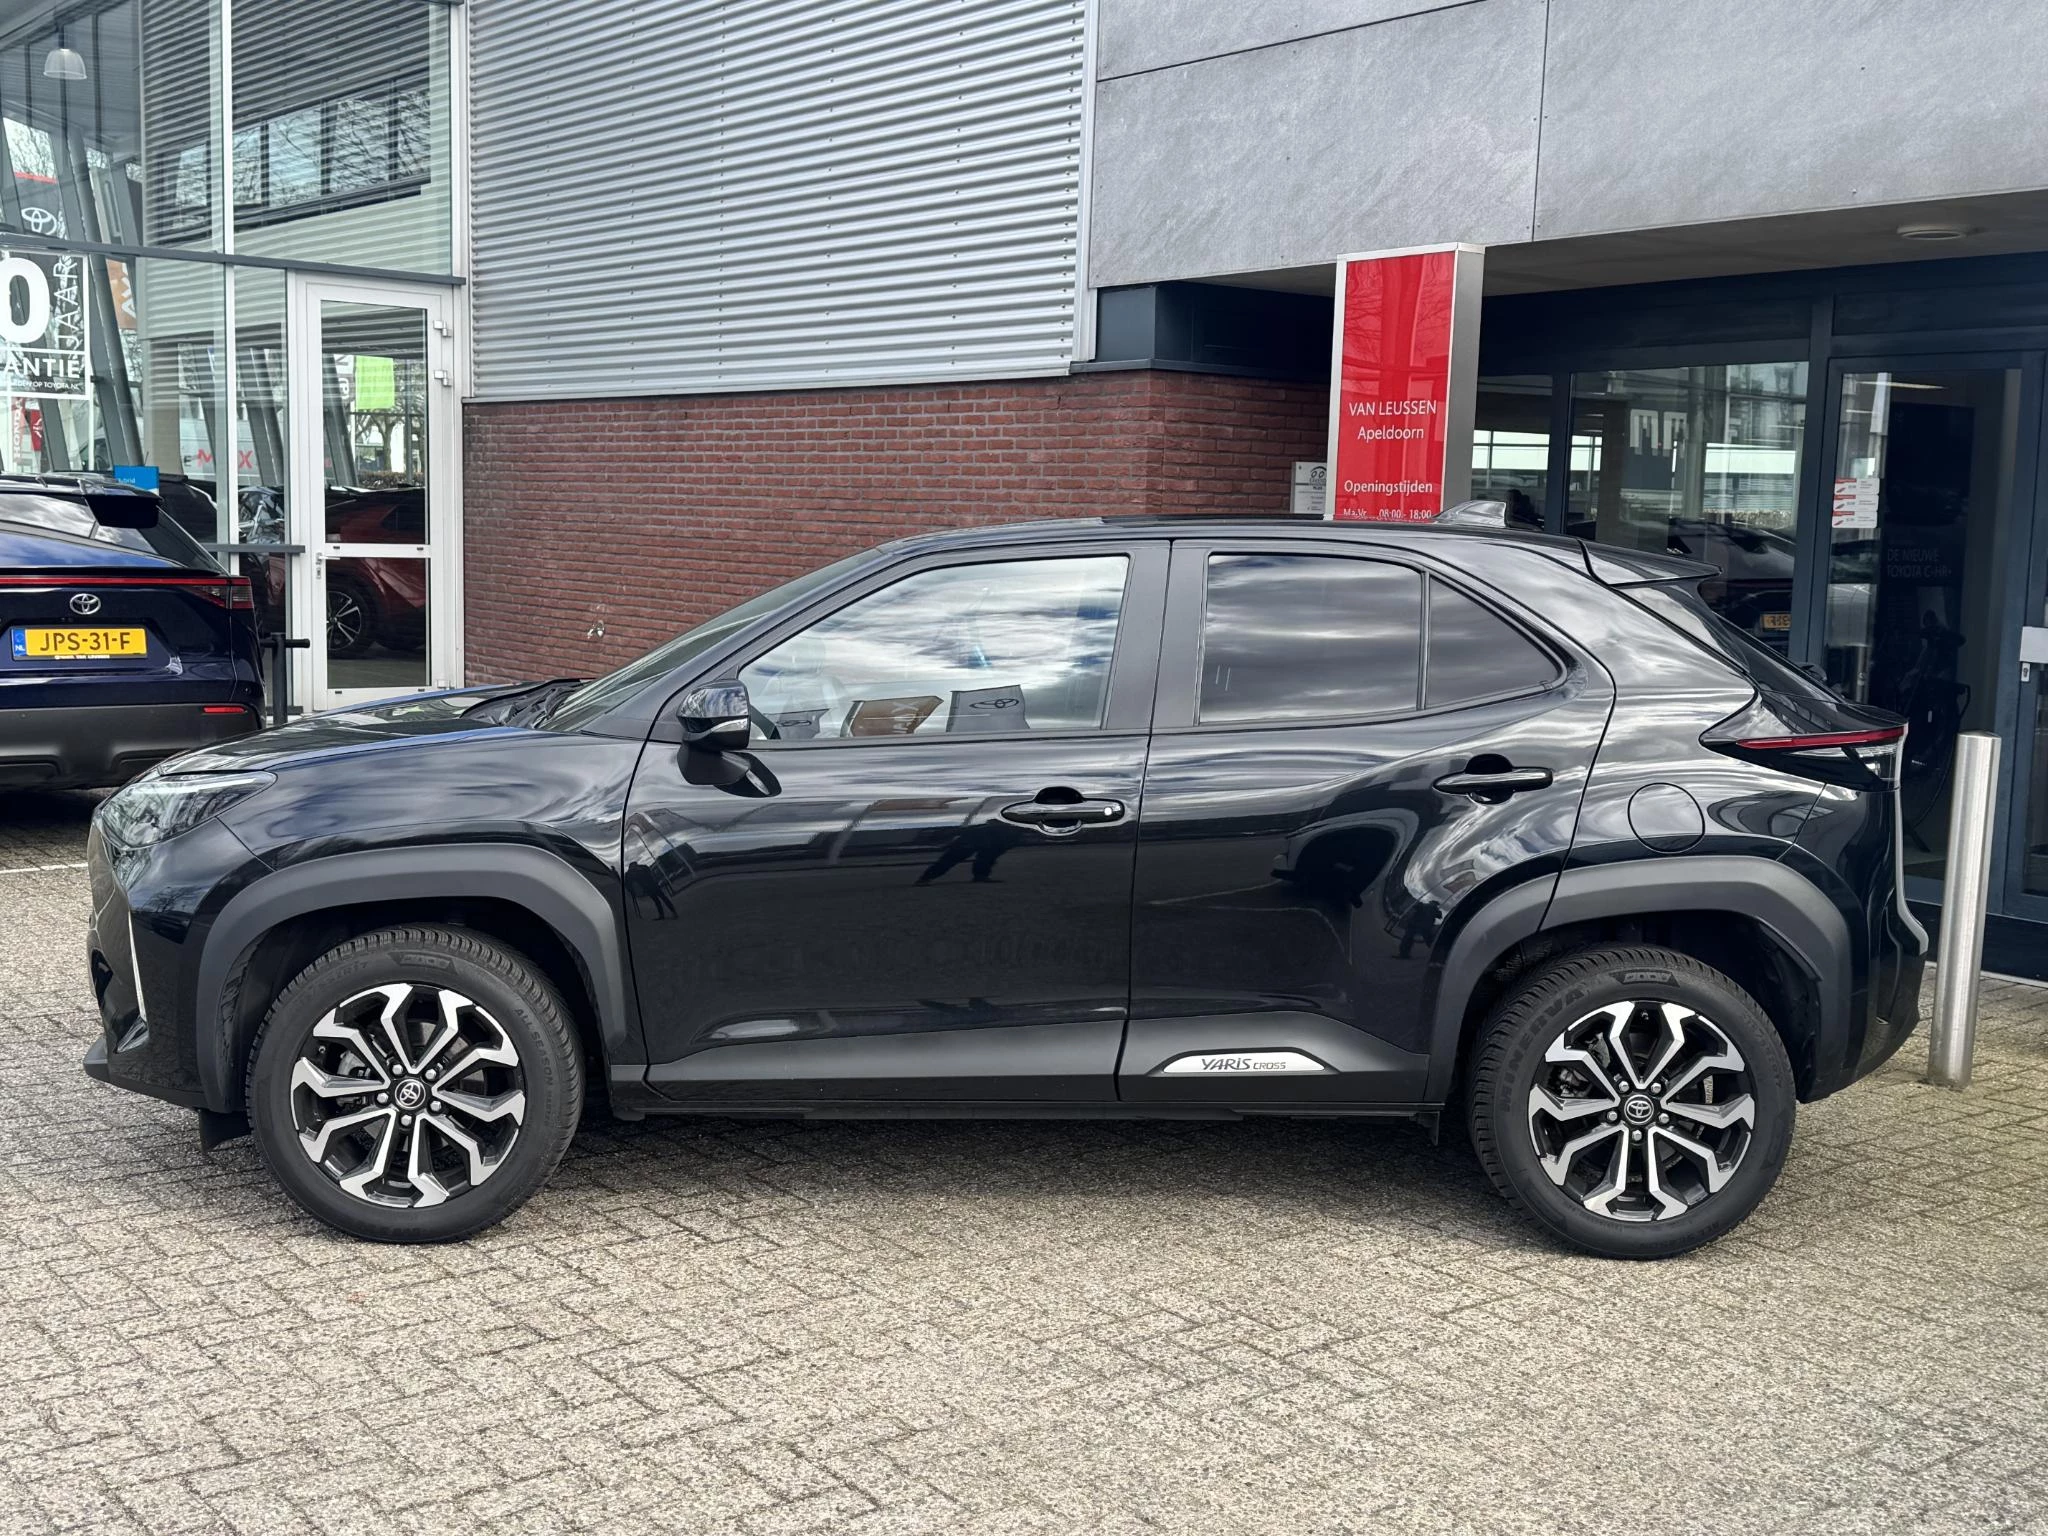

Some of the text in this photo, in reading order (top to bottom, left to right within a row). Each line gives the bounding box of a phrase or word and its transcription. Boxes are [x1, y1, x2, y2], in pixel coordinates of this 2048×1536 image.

[53, 261, 80, 352] JAAR
[1349, 400, 1437, 416] VAN LEUSSEN
[1357, 425, 1424, 443] Apeldoorn
[1344, 480, 1433, 496] Openingstijden
[40, 632, 131, 651] JPS-31-F
[1253, 1061, 1287, 1070] CROSS
